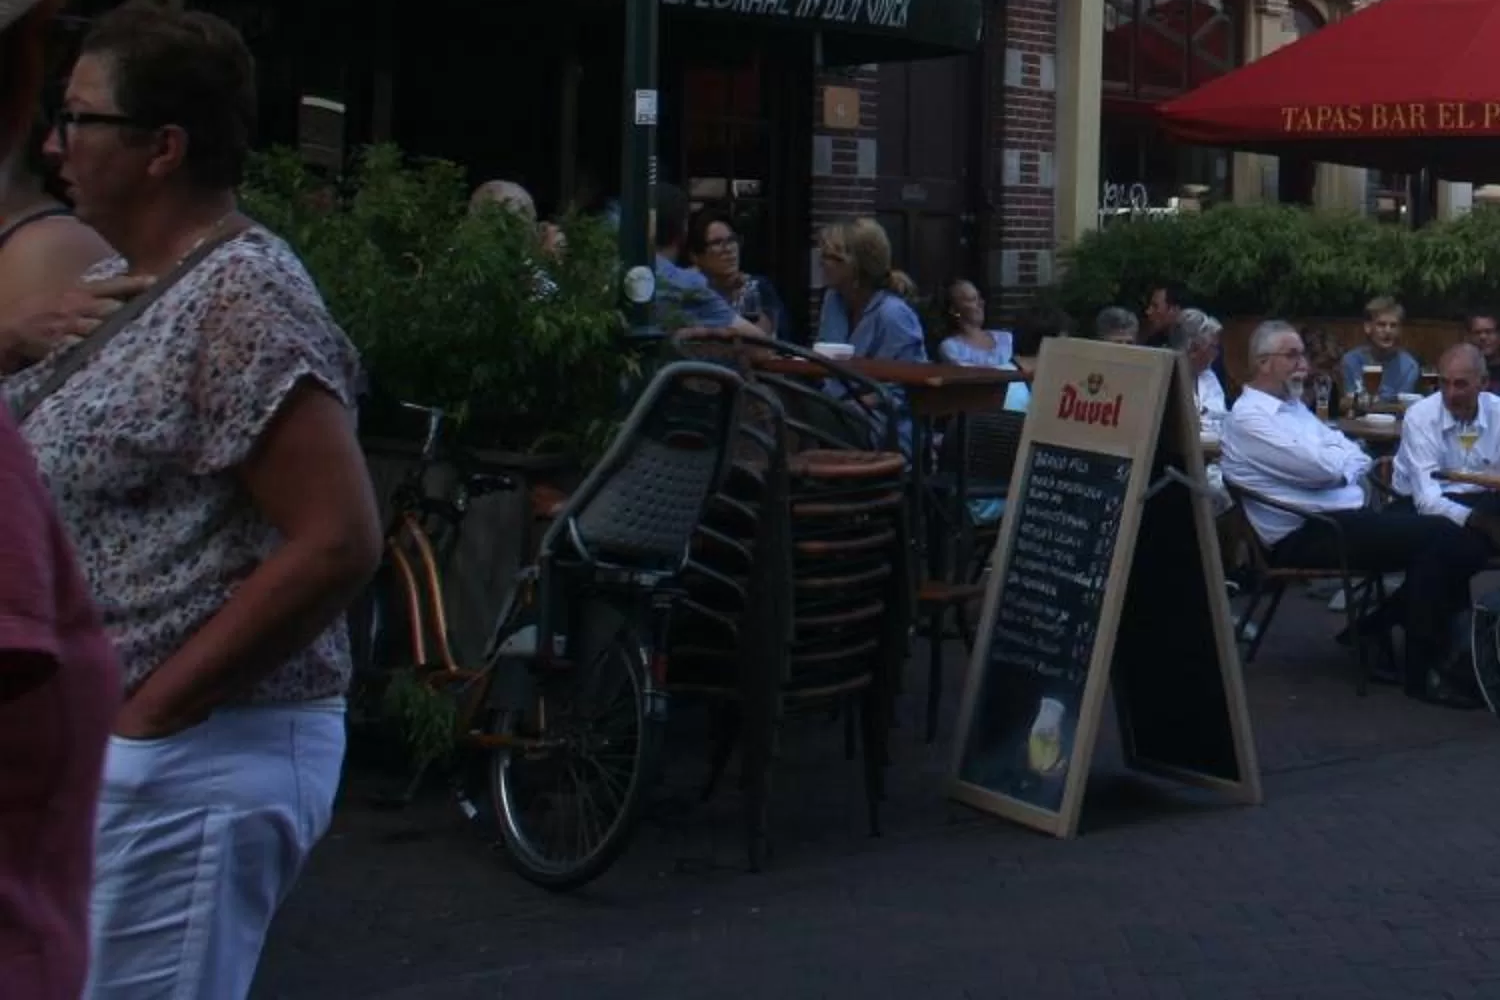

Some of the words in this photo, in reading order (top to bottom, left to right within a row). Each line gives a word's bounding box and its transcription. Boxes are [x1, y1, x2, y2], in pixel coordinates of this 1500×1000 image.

[1282, 106, 1363, 132] TAPAS
[1371, 103, 1428, 130] BAR
[1438, 102, 1475, 129] EL
[1058, 384, 1122, 428] Duvel
